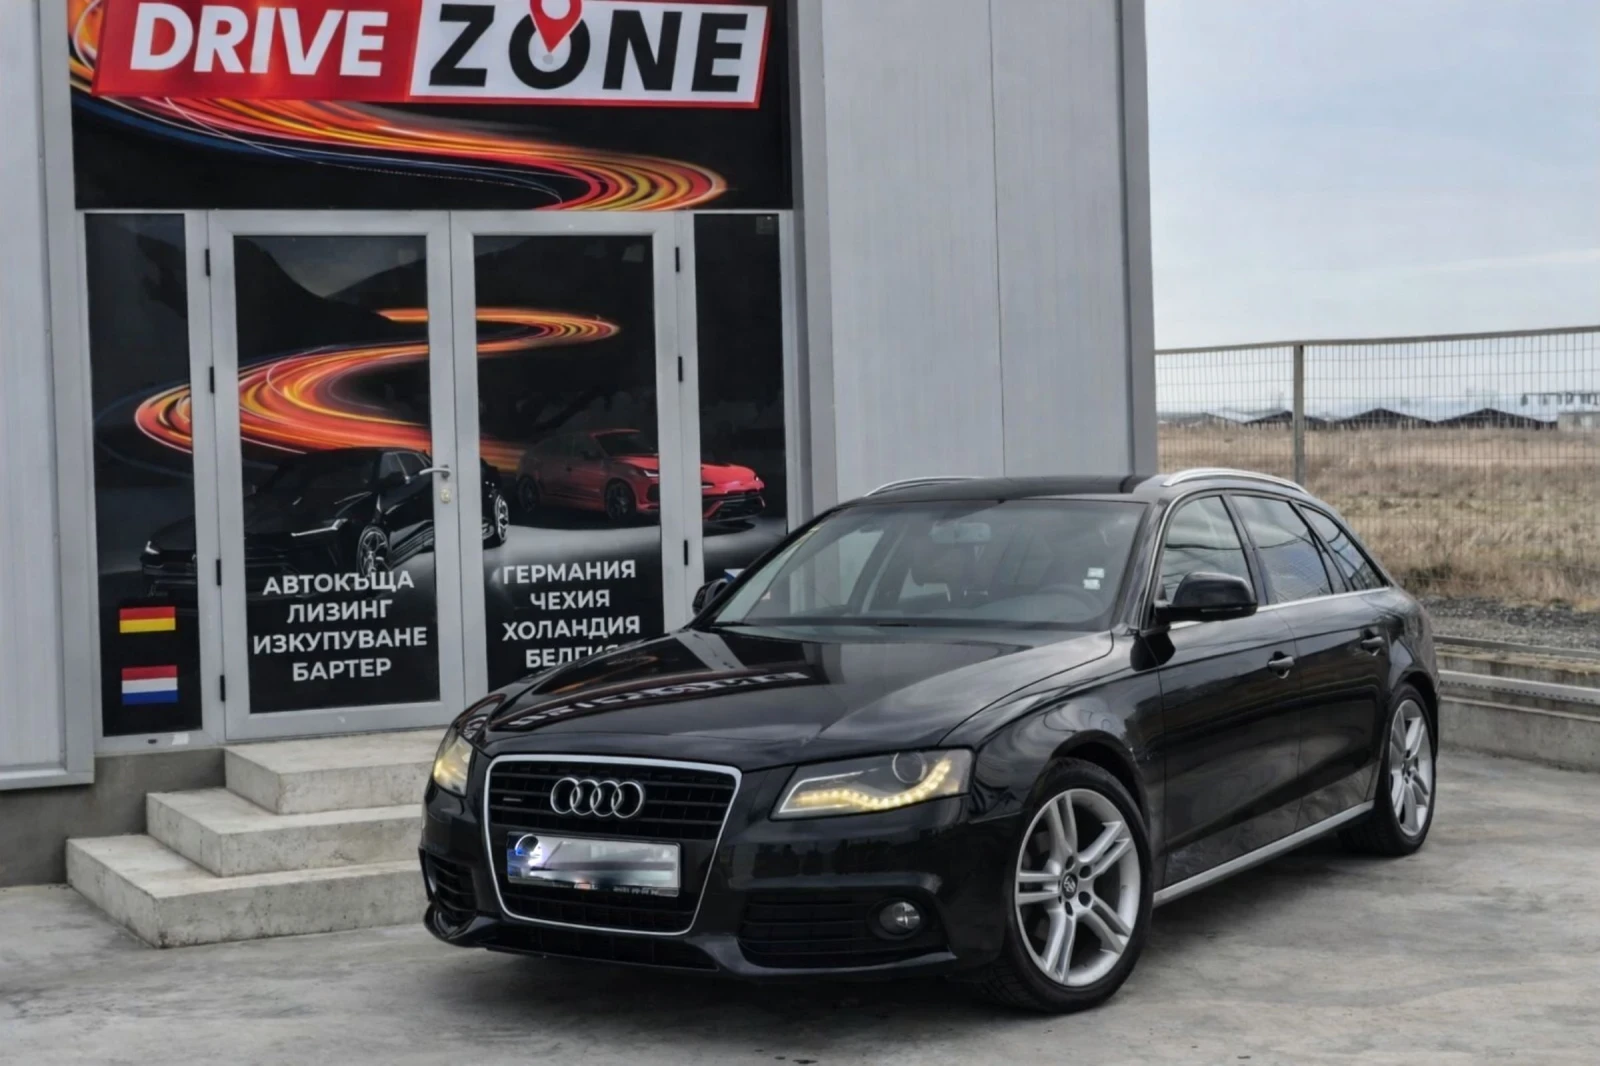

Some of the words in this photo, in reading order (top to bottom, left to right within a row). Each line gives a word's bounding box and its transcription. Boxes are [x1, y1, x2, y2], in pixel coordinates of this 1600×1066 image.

[130, 2, 388, 77] DRIVE
[428, 3, 748, 93] ZONE
[262, 569, 415, 596] АВТОКЪЩА
[502, 559, 637, 585] ГЕРМАНИЯ
[286, 599, 393, 624] ЛИЗИНГ
[530, 589, 611, 611] ЧЕХИЯ
[252, 626, 428, 655] ИЗКУПУВАНЕ
[501, 615, 641, 642] ХОЛАНДИЯ
[291, 657, 392, 682] БАРТЕР
[525, 644, 619, 669] БЕЛГ
